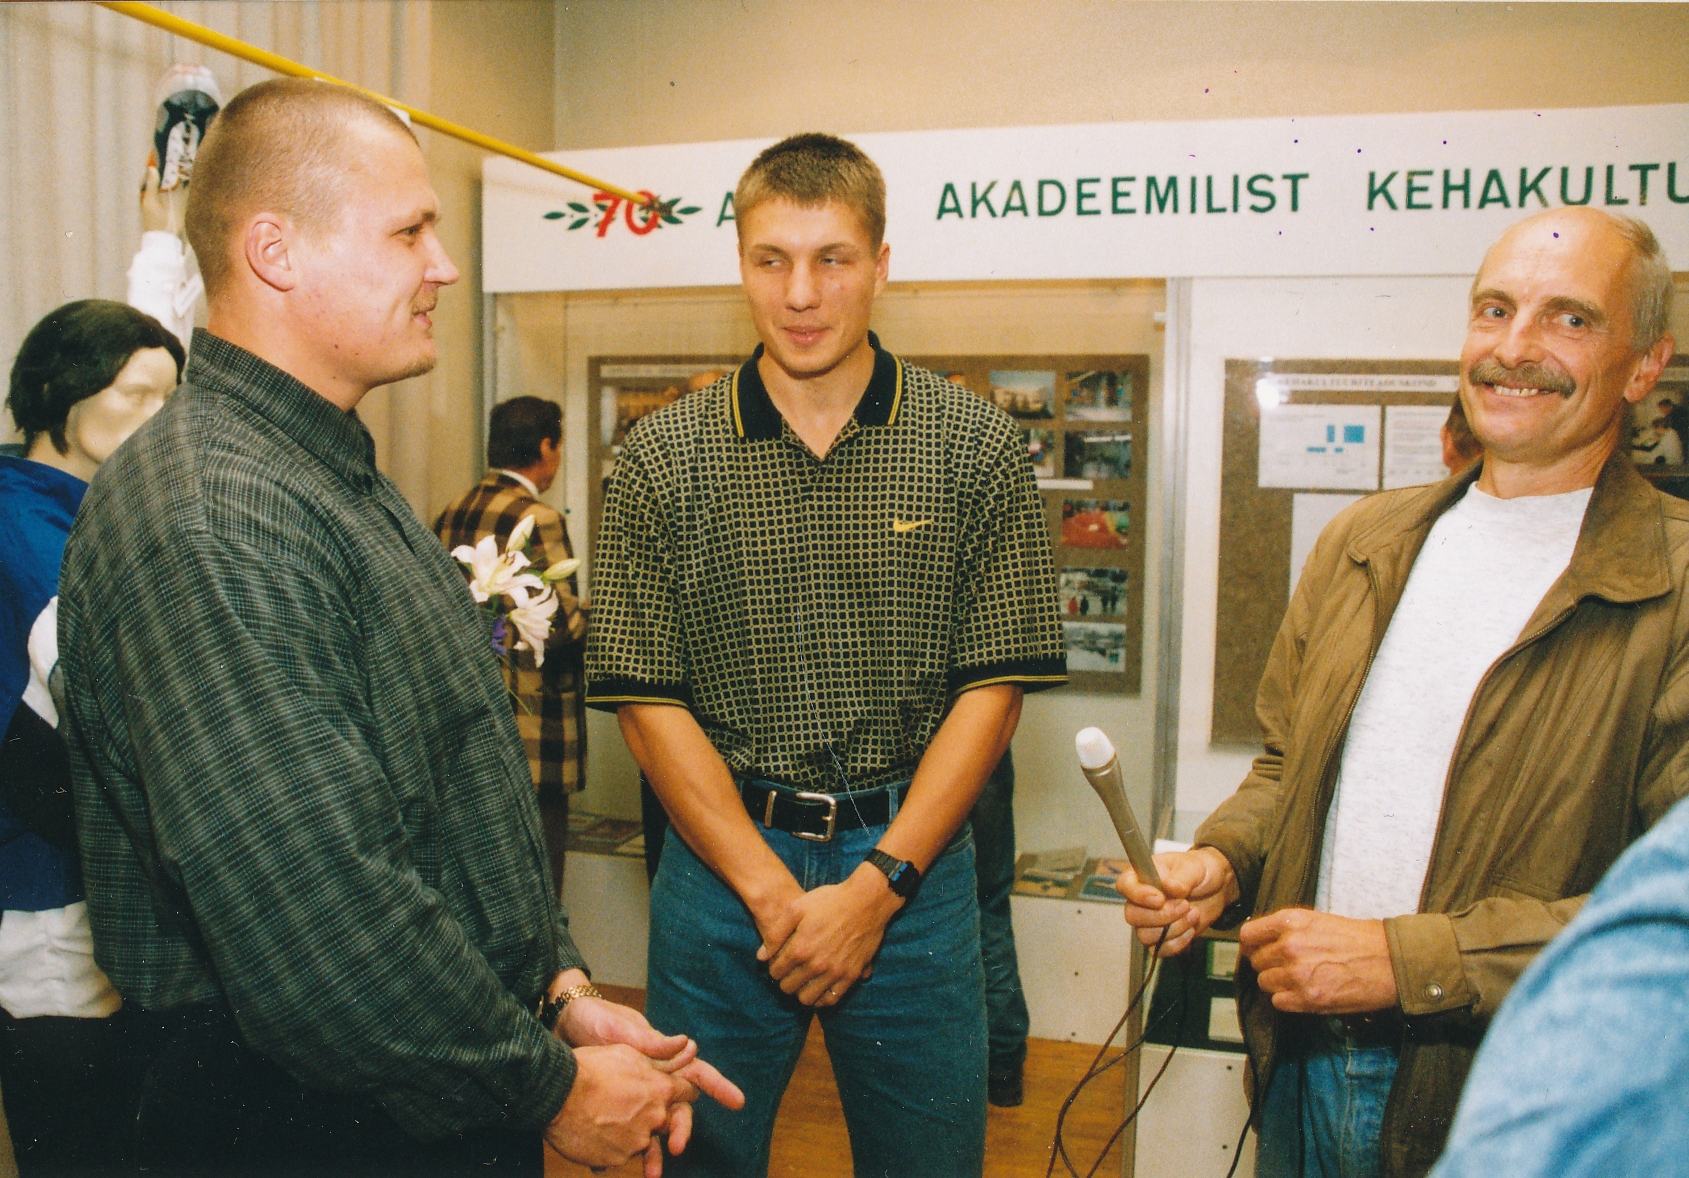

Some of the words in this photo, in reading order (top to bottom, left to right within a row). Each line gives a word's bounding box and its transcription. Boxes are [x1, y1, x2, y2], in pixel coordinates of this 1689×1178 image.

[592, 189, 660, 238] 70
[936, 172, 1310, 220] AKADEEMILIST
[1366, 161, 1689, 211] KEHAKULTU
